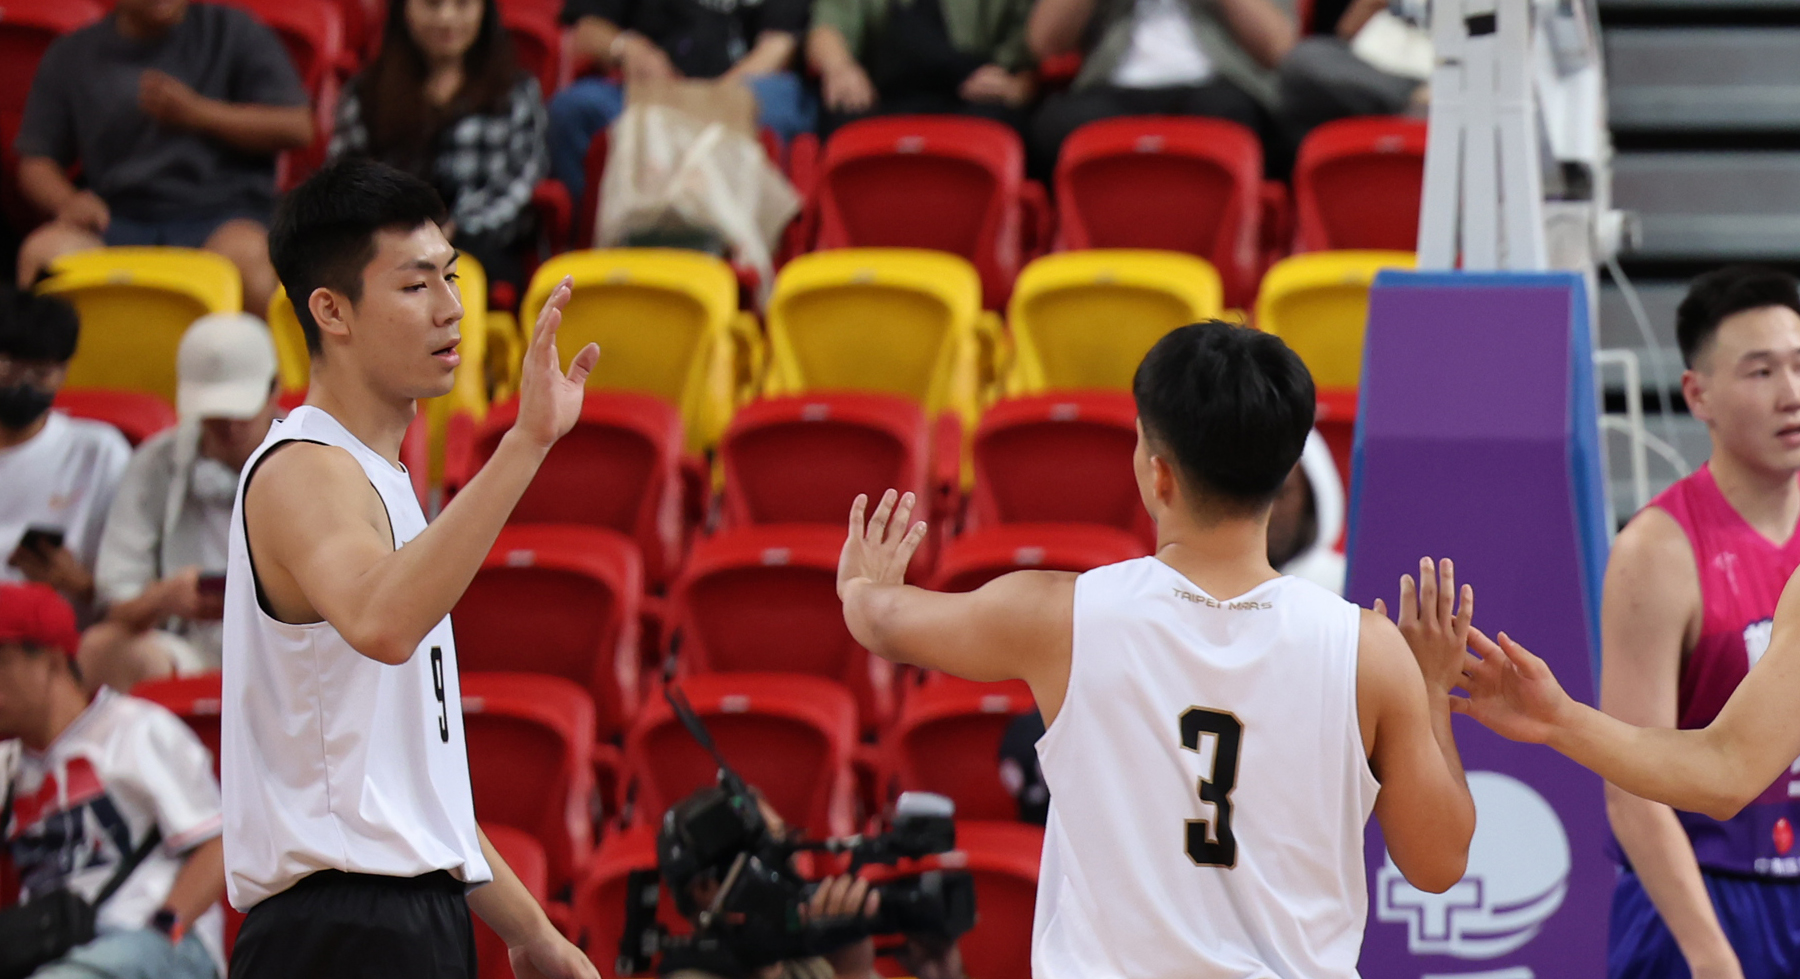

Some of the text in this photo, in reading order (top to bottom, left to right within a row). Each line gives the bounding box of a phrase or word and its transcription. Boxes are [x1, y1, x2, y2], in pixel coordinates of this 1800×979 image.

[1172, 587, 1273, 611] TAIPEI MARS
[431, 645, 449, 743] 9
[1178, 705, 1245, 870] 3
